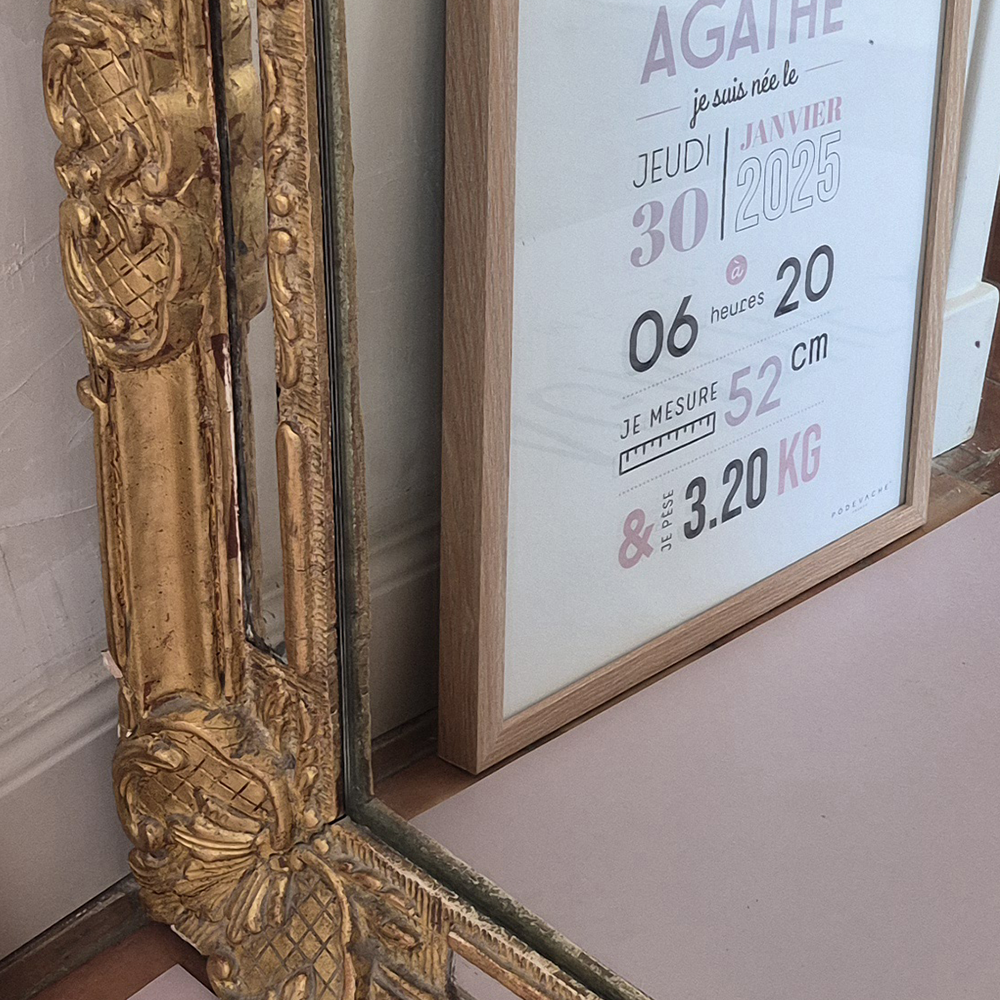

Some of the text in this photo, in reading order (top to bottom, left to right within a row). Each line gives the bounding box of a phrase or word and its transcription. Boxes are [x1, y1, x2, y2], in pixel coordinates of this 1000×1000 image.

[640, 0, 844, 85] AGATHE
[690, 59, 798, 129] je suis née le
[740, 96, 843, 151] JANVIER
[632, 134, 711, 188] JEUDI
[735, 130, 841, 233] 2025
[630, 187, 709, 268] 30
[629, 244, 835, 373] 06 heures 20
[620, 332, 828, 440] JE MESURE 52 cm
[683, 423, 822, 540] 3.20 KG
[618, 508, 655, 569] &
[660, 532, 672, 552] JE
